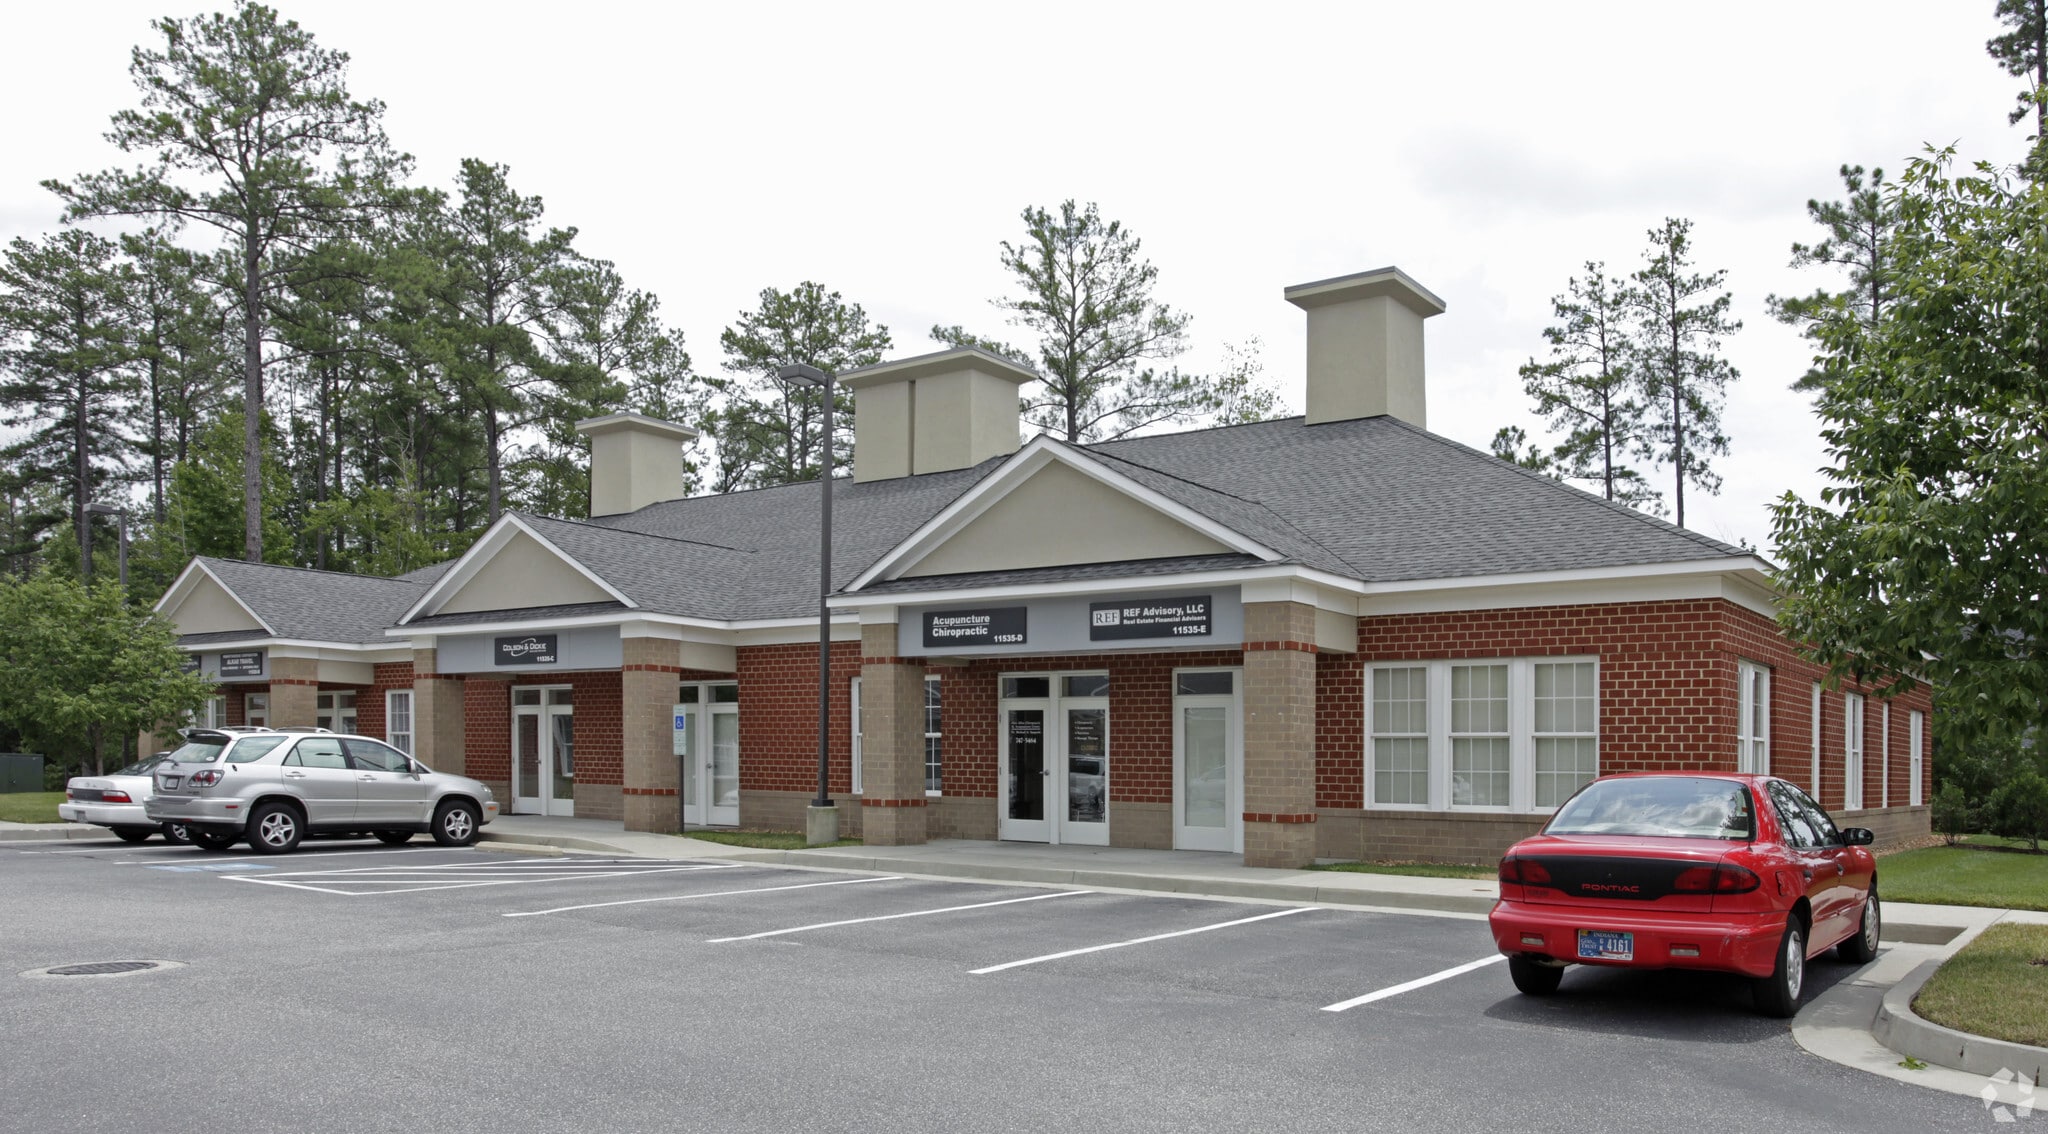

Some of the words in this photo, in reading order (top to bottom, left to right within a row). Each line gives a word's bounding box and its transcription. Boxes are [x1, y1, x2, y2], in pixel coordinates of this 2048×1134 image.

[1123, 607, 1141, 618] REF
[1143, 606, 1184, 617] Advisory,
[1186, 604, 1205, 614] LLC
[932, 615, 990, 627] Acupuncture
[1095, 611, 1118, 624] REF
[1155, 616, 1181, 624] Financial
[932, 626, 988, 638] Chiropractic
[1172, 625, 1207, 635] 11535-E
[993, 633, 1024, 643] 11535-D
[1581, 883, 1640, 893] PONTIAC
[1593, 931, 1619, 939] INDIANA
[1607, 938, 1630, 953] 4161
